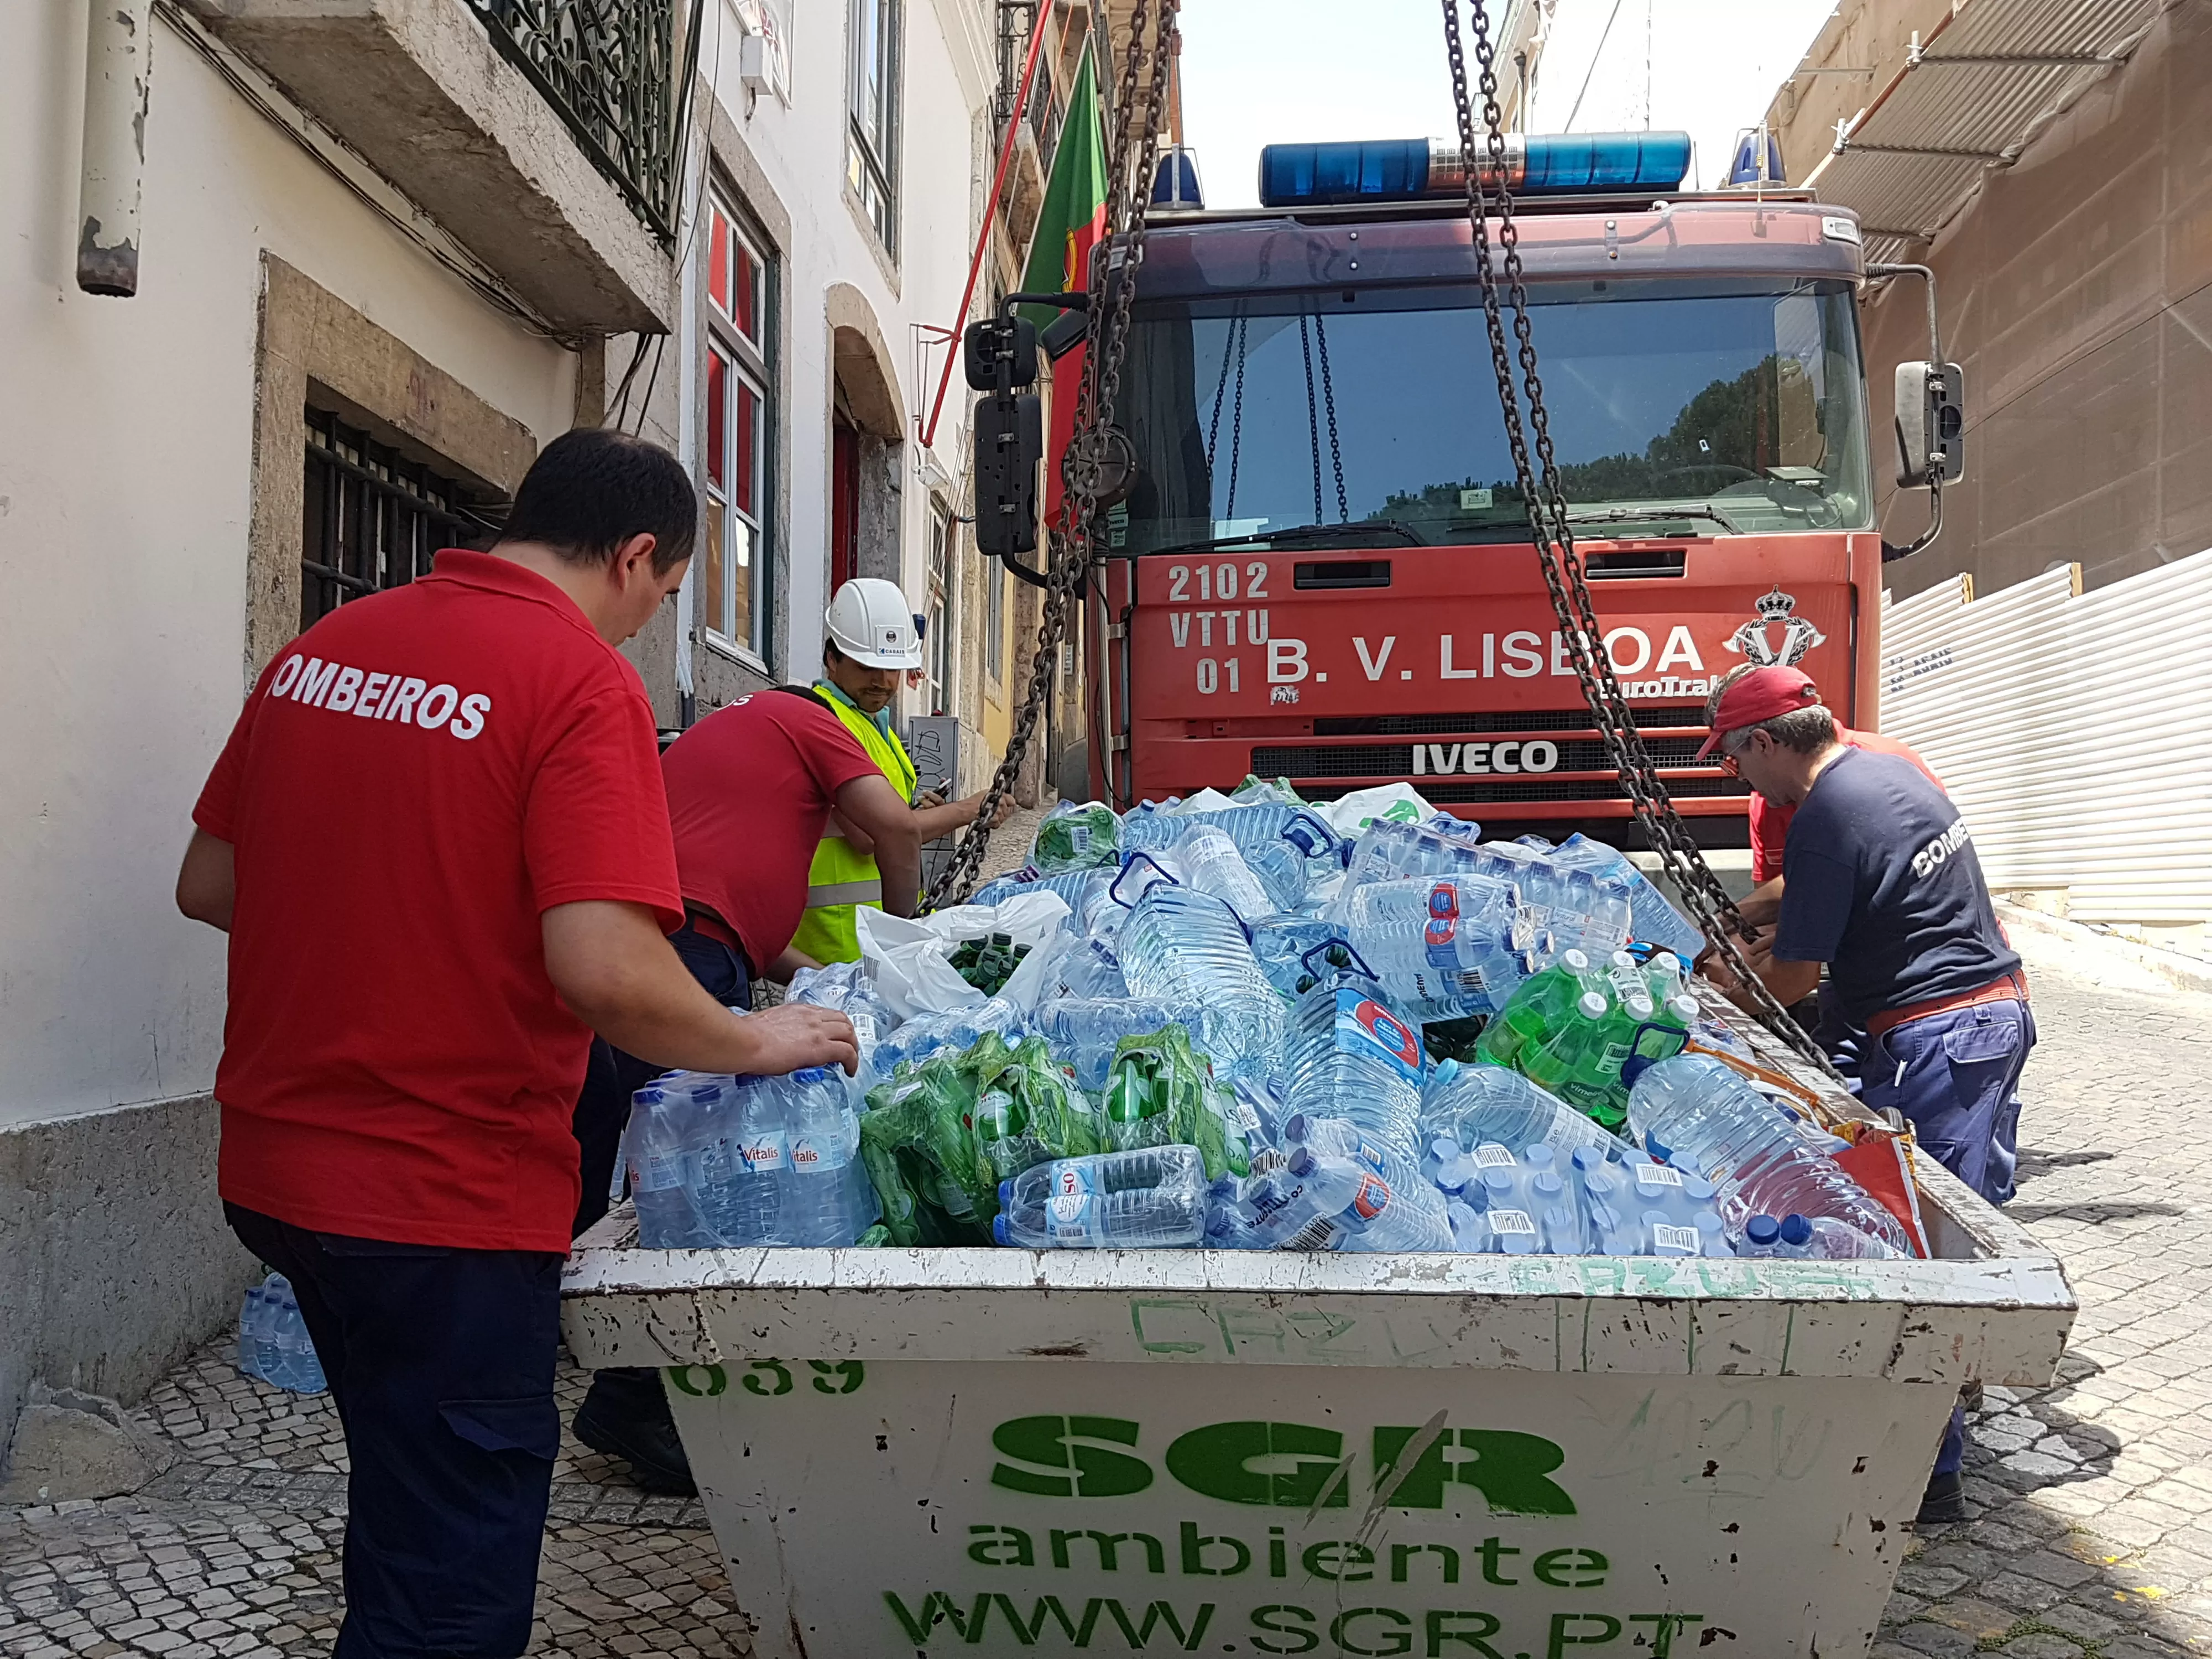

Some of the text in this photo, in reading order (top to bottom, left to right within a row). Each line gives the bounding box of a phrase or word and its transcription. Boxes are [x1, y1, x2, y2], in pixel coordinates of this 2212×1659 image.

[1169, 562, 1268, 601] 2102
[1169, 609, 1269, 648] VTTU
[1267, 625, 1705, 683] B. V. LISBOA
[1197, 658, 1239, 694] 01
[1596, 675, 1719, 700] EuroTra
[264, 653, 492, 740] OMBEIROS
[1412, 740, 1558, 775] IVECO
[1912, 818, 1969, 878] BOMBE
[744, 1146, 779, 1161] Vitalis
[1063, 1172, 1076, 1196] SO
[991, 1414, 1578, 1515] SGR
[967, 1521, 1609, 1588] ambiente
[884, 1590, 1704, 1659] WWW.SGR.PT
